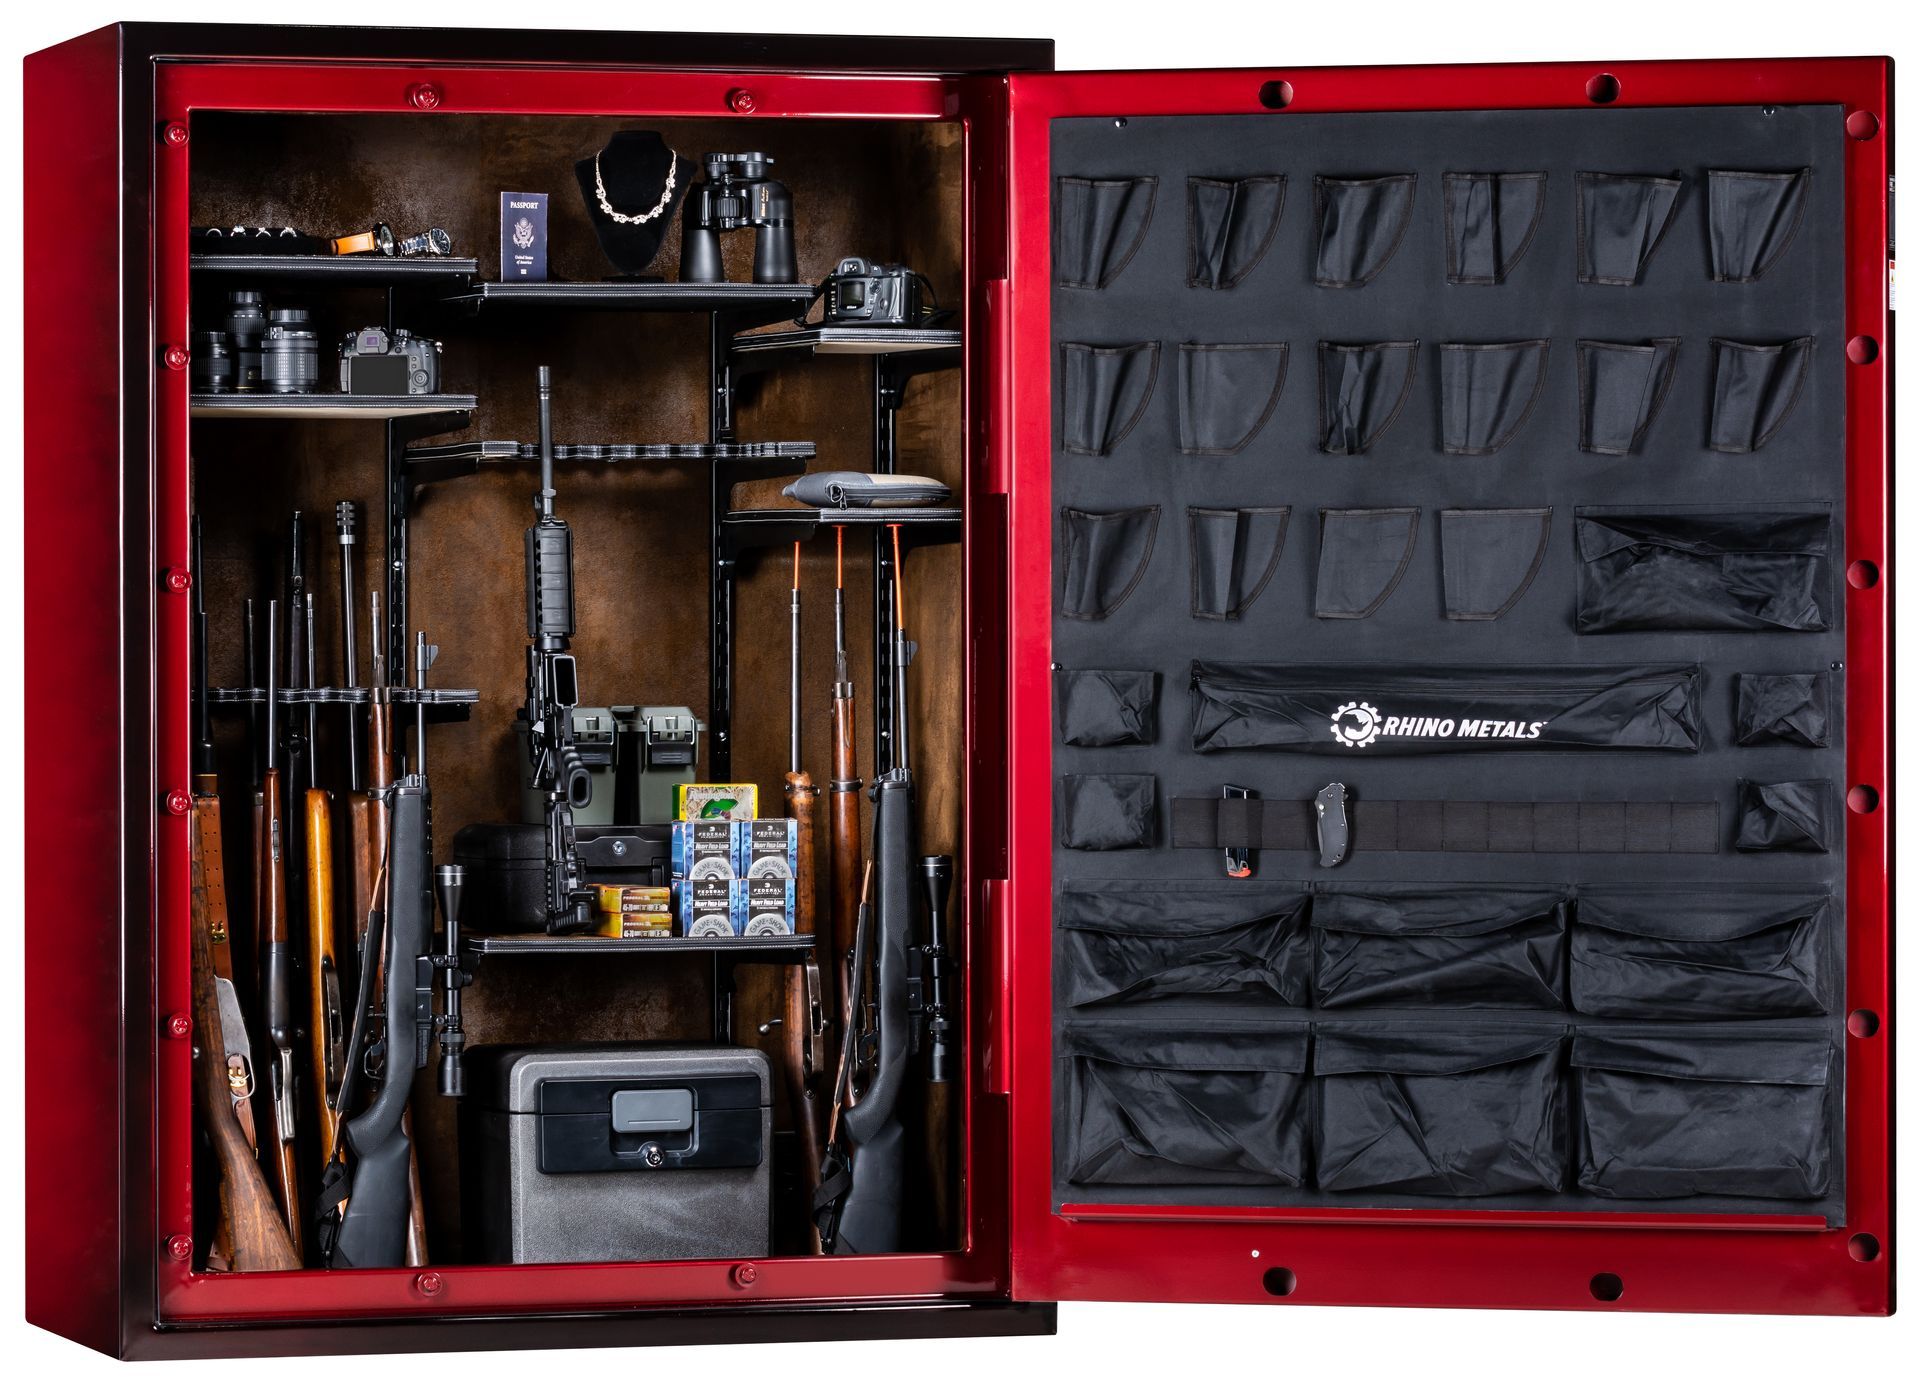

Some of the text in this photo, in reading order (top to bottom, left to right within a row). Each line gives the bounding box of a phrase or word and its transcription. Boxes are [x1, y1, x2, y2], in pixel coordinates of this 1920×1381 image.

[510, 201, 539, 209] PASSPORT
[1382, 716, 1543, 739] RHINO METALS
